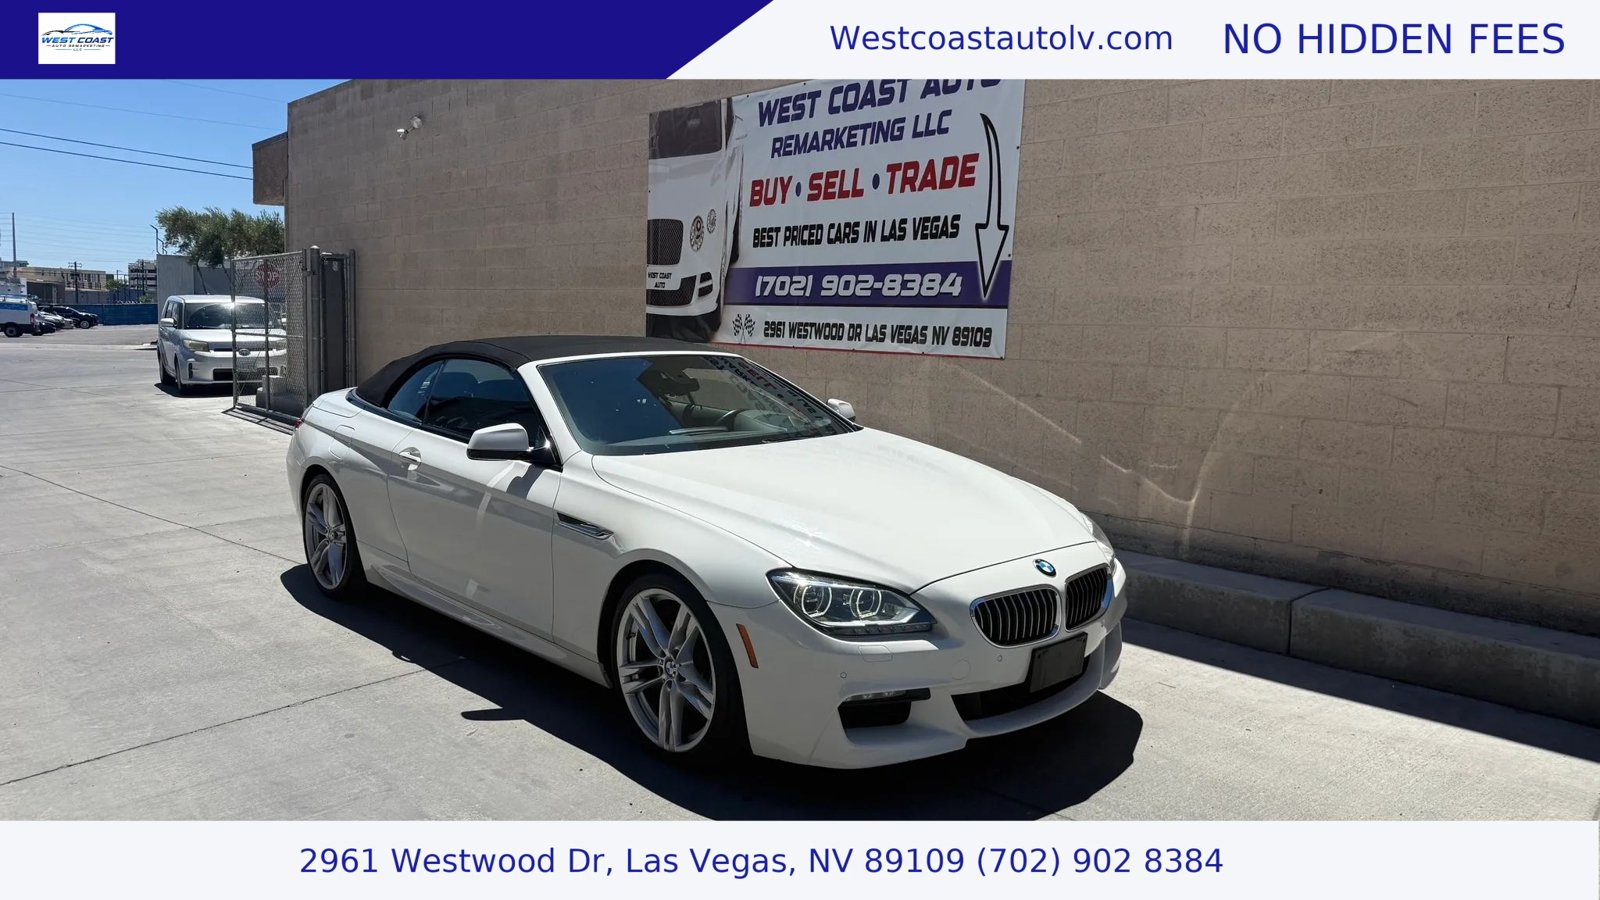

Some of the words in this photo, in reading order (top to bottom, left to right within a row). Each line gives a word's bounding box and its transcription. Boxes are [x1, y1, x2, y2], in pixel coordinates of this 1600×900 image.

[758, 90, 821, 127] WEST
[828, 79, 912, 115] COAST
[770, 117, 906, 158] REMARKETING
[912, 109, 952, 138] LLC
[749, 176, 793, 207] BUY
[807, 168, 864, 201] SELL
[886, 152, 979, 194] TRADE
[753, 226, 781, 248] BEST
[783, 223, 824, 247] PRICED
[827, 221, 860, 244] CARS
[863, 220, 878, 243] IN
[880, 218, 907, 242] LAS
[912, 214, 961, 240] VEGAS
[821, 273, 963, 297] 902-8384
[763, 321, 786, 338] 2961
[788, 321, 845, 341] WESTWOOD
[847, 323, 863, 342] DR
[865, 324, 887, 343] LAS
[890, 325, 928, 345] VEGAS
[931, 326, 950, 346] NV
[952, 326, 993, 348] 89109
